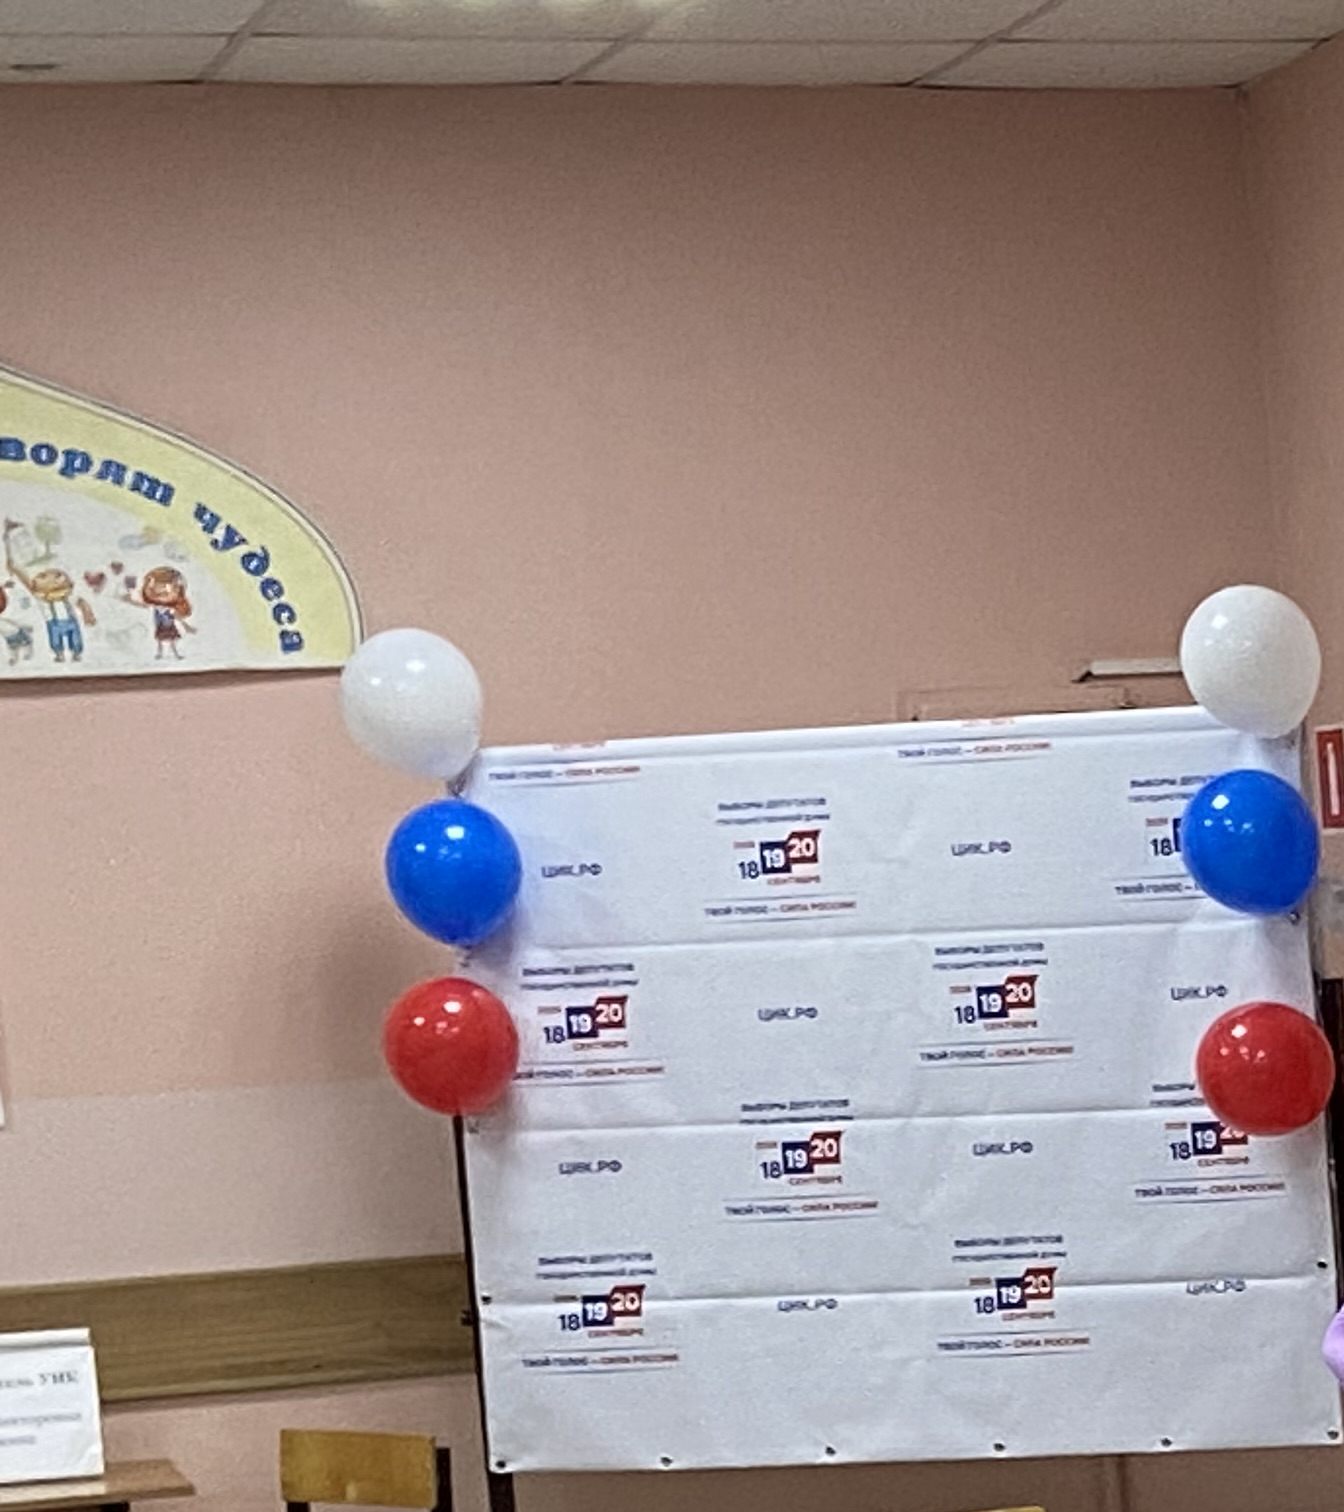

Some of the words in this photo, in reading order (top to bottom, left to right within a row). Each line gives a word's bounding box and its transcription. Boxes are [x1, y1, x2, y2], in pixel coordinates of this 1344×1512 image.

[193, 502, 303, 653] чудеса
[738, 861, 760, 879] 18
[763, 849, 785, 868] 19
[788, 838, 815, 858] 20
[1150, 838, 1173, 856] 18
[954, 1006, 976, 1023] 18
[979, 994, 1002, 1013] 19
[1006, 983, 1032, 1003] 20
[544, 1026, 566, 1043] 18
[569, 1014, 592, 1032] 19
[595, 1004, 622, 1023] 20
[760, 1161, 782, 1179] 18
[785, 1149, 807, 1168] 19
[811, 1138, 838, 1158] 20
[1170, 1142, 1192, 1160] 18
[1195, 1129, 1217, 1149] 19
[558, 1313, 580, 1331] 18
[585, 1302, 608, 1321] 19
[611, 1293, 640, 1311] 20
[974, 1296, 996, 1313] 18
[999, 1285, 1022, 1303] 19
[1024, 1275, 1051, 1294] 20
